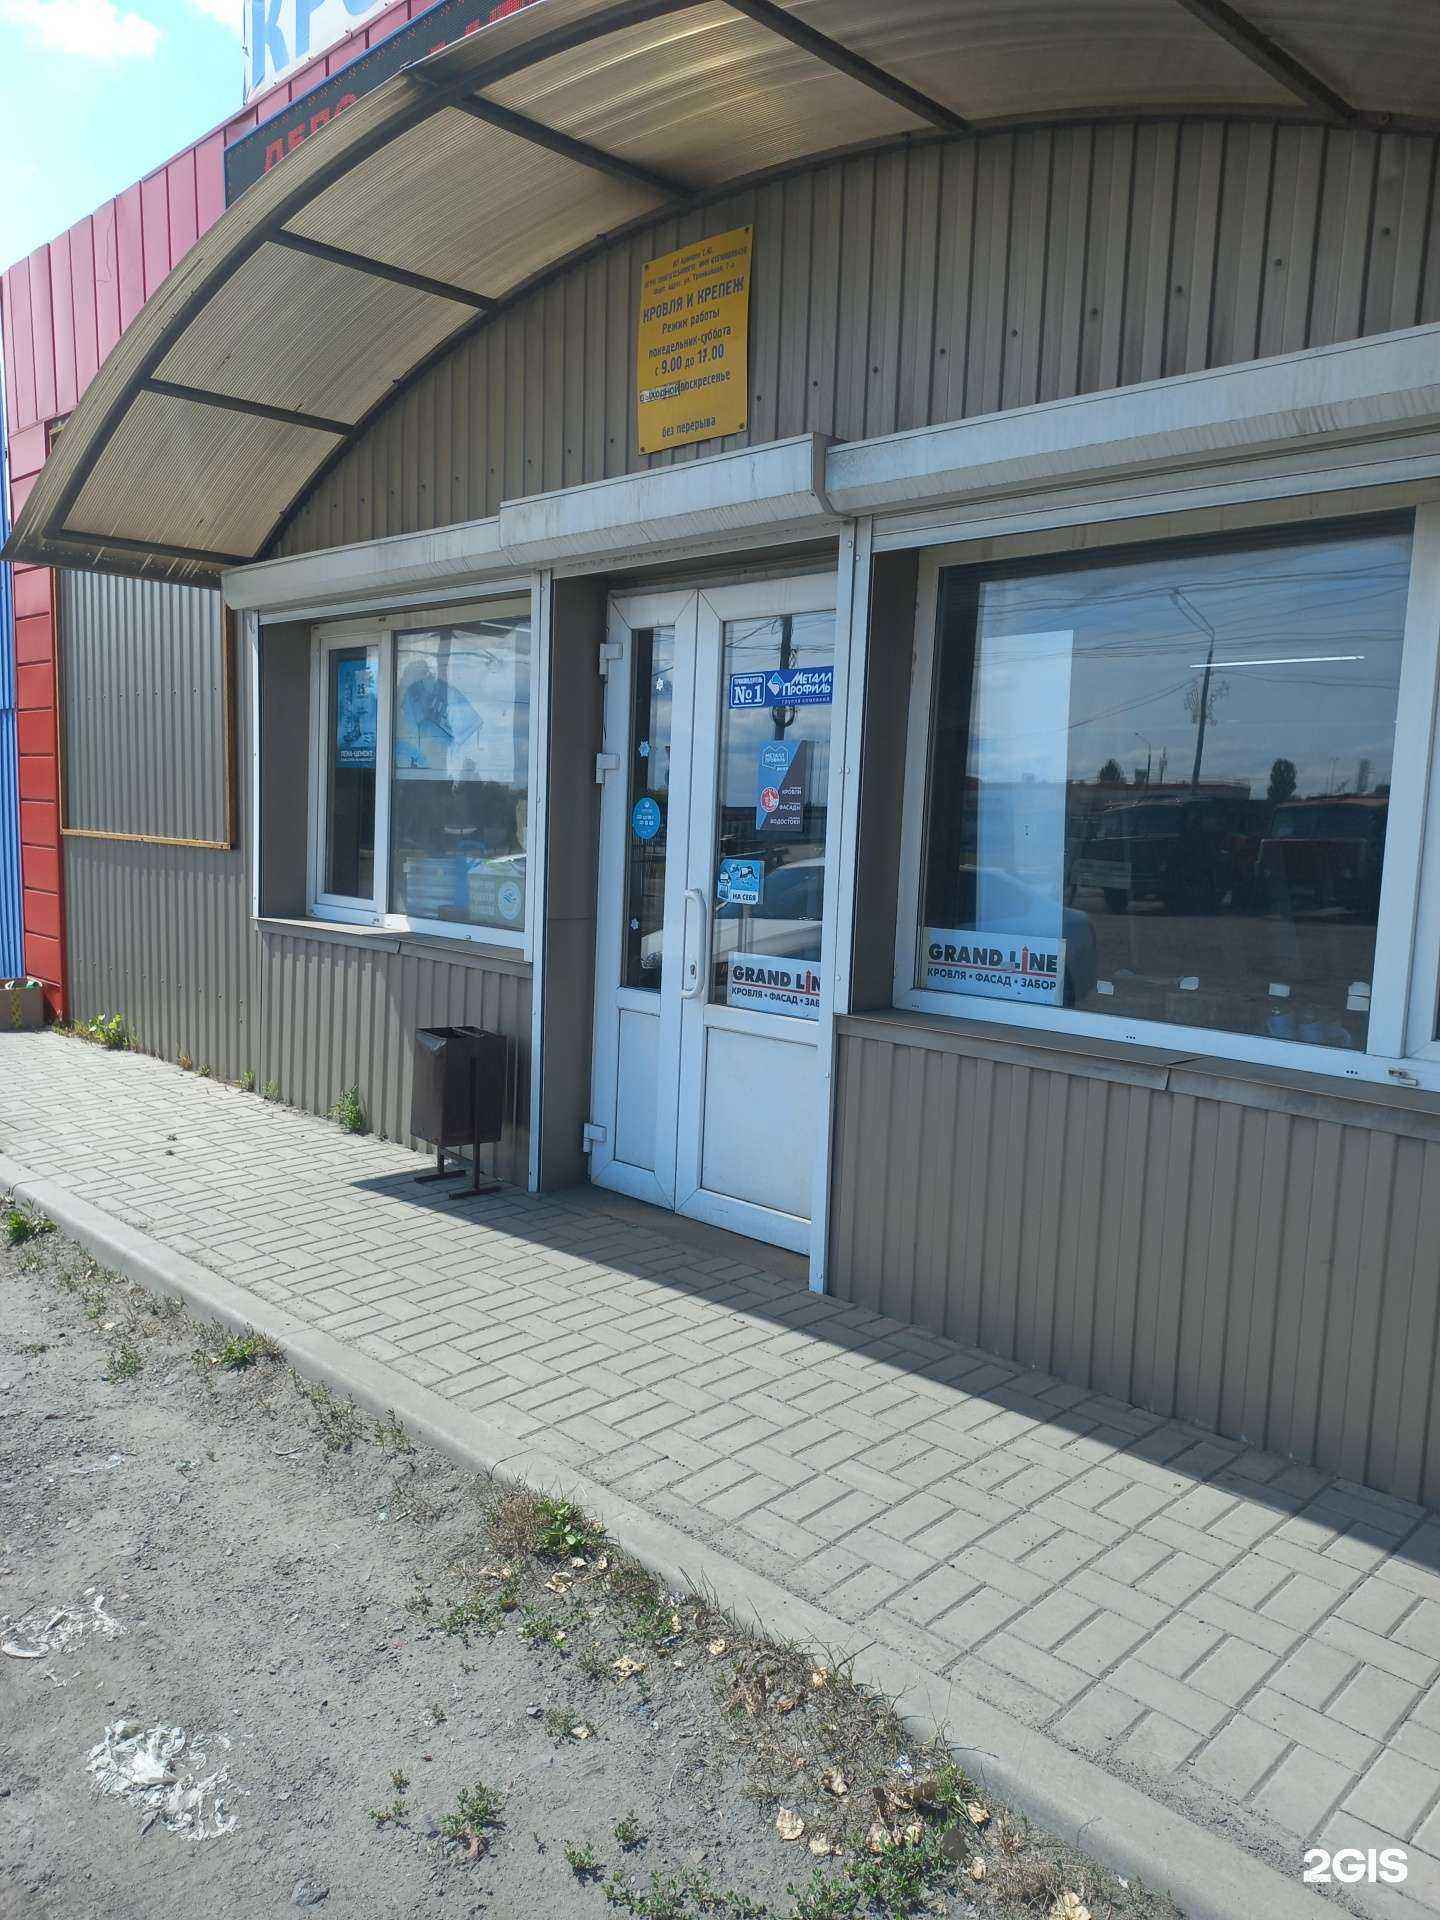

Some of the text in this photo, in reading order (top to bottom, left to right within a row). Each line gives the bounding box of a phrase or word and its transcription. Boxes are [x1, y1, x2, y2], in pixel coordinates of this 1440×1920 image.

[643, 297, 683, 323] КРОВЛЯ
[687, 293, 694, 309] И
[697, 275, 745, 304] КРЕПЕЖ
[662, 308, 720, 334] Режим работы
[648, 326, 732, 359] понедельник-суббота
[661, 355, 682, 375] 9.00
[685, 357, 695, 370] до
[698, 343, 724, 364] 17.00
[662, 415, 716, 438] без перерыва
[782, 682, 831, 696] ПРОФИЛЬ
[791, 671, 833, 685] МЕТАЛЛ
[734, 685, 762, 704] №1
[743, 893, 756, 901] СЕБЯ
[928, 943, 1058, 974] GRAND LINE
[733, 965, 820, 993] GRAND LIN
[928, 967, 1056, 990] КРОВЛЯ ФАСАД ЗАБОР
[731, 986, 763, 998] КРОВЛЯ
[769, 991, 798, 1005] ФАСАД
